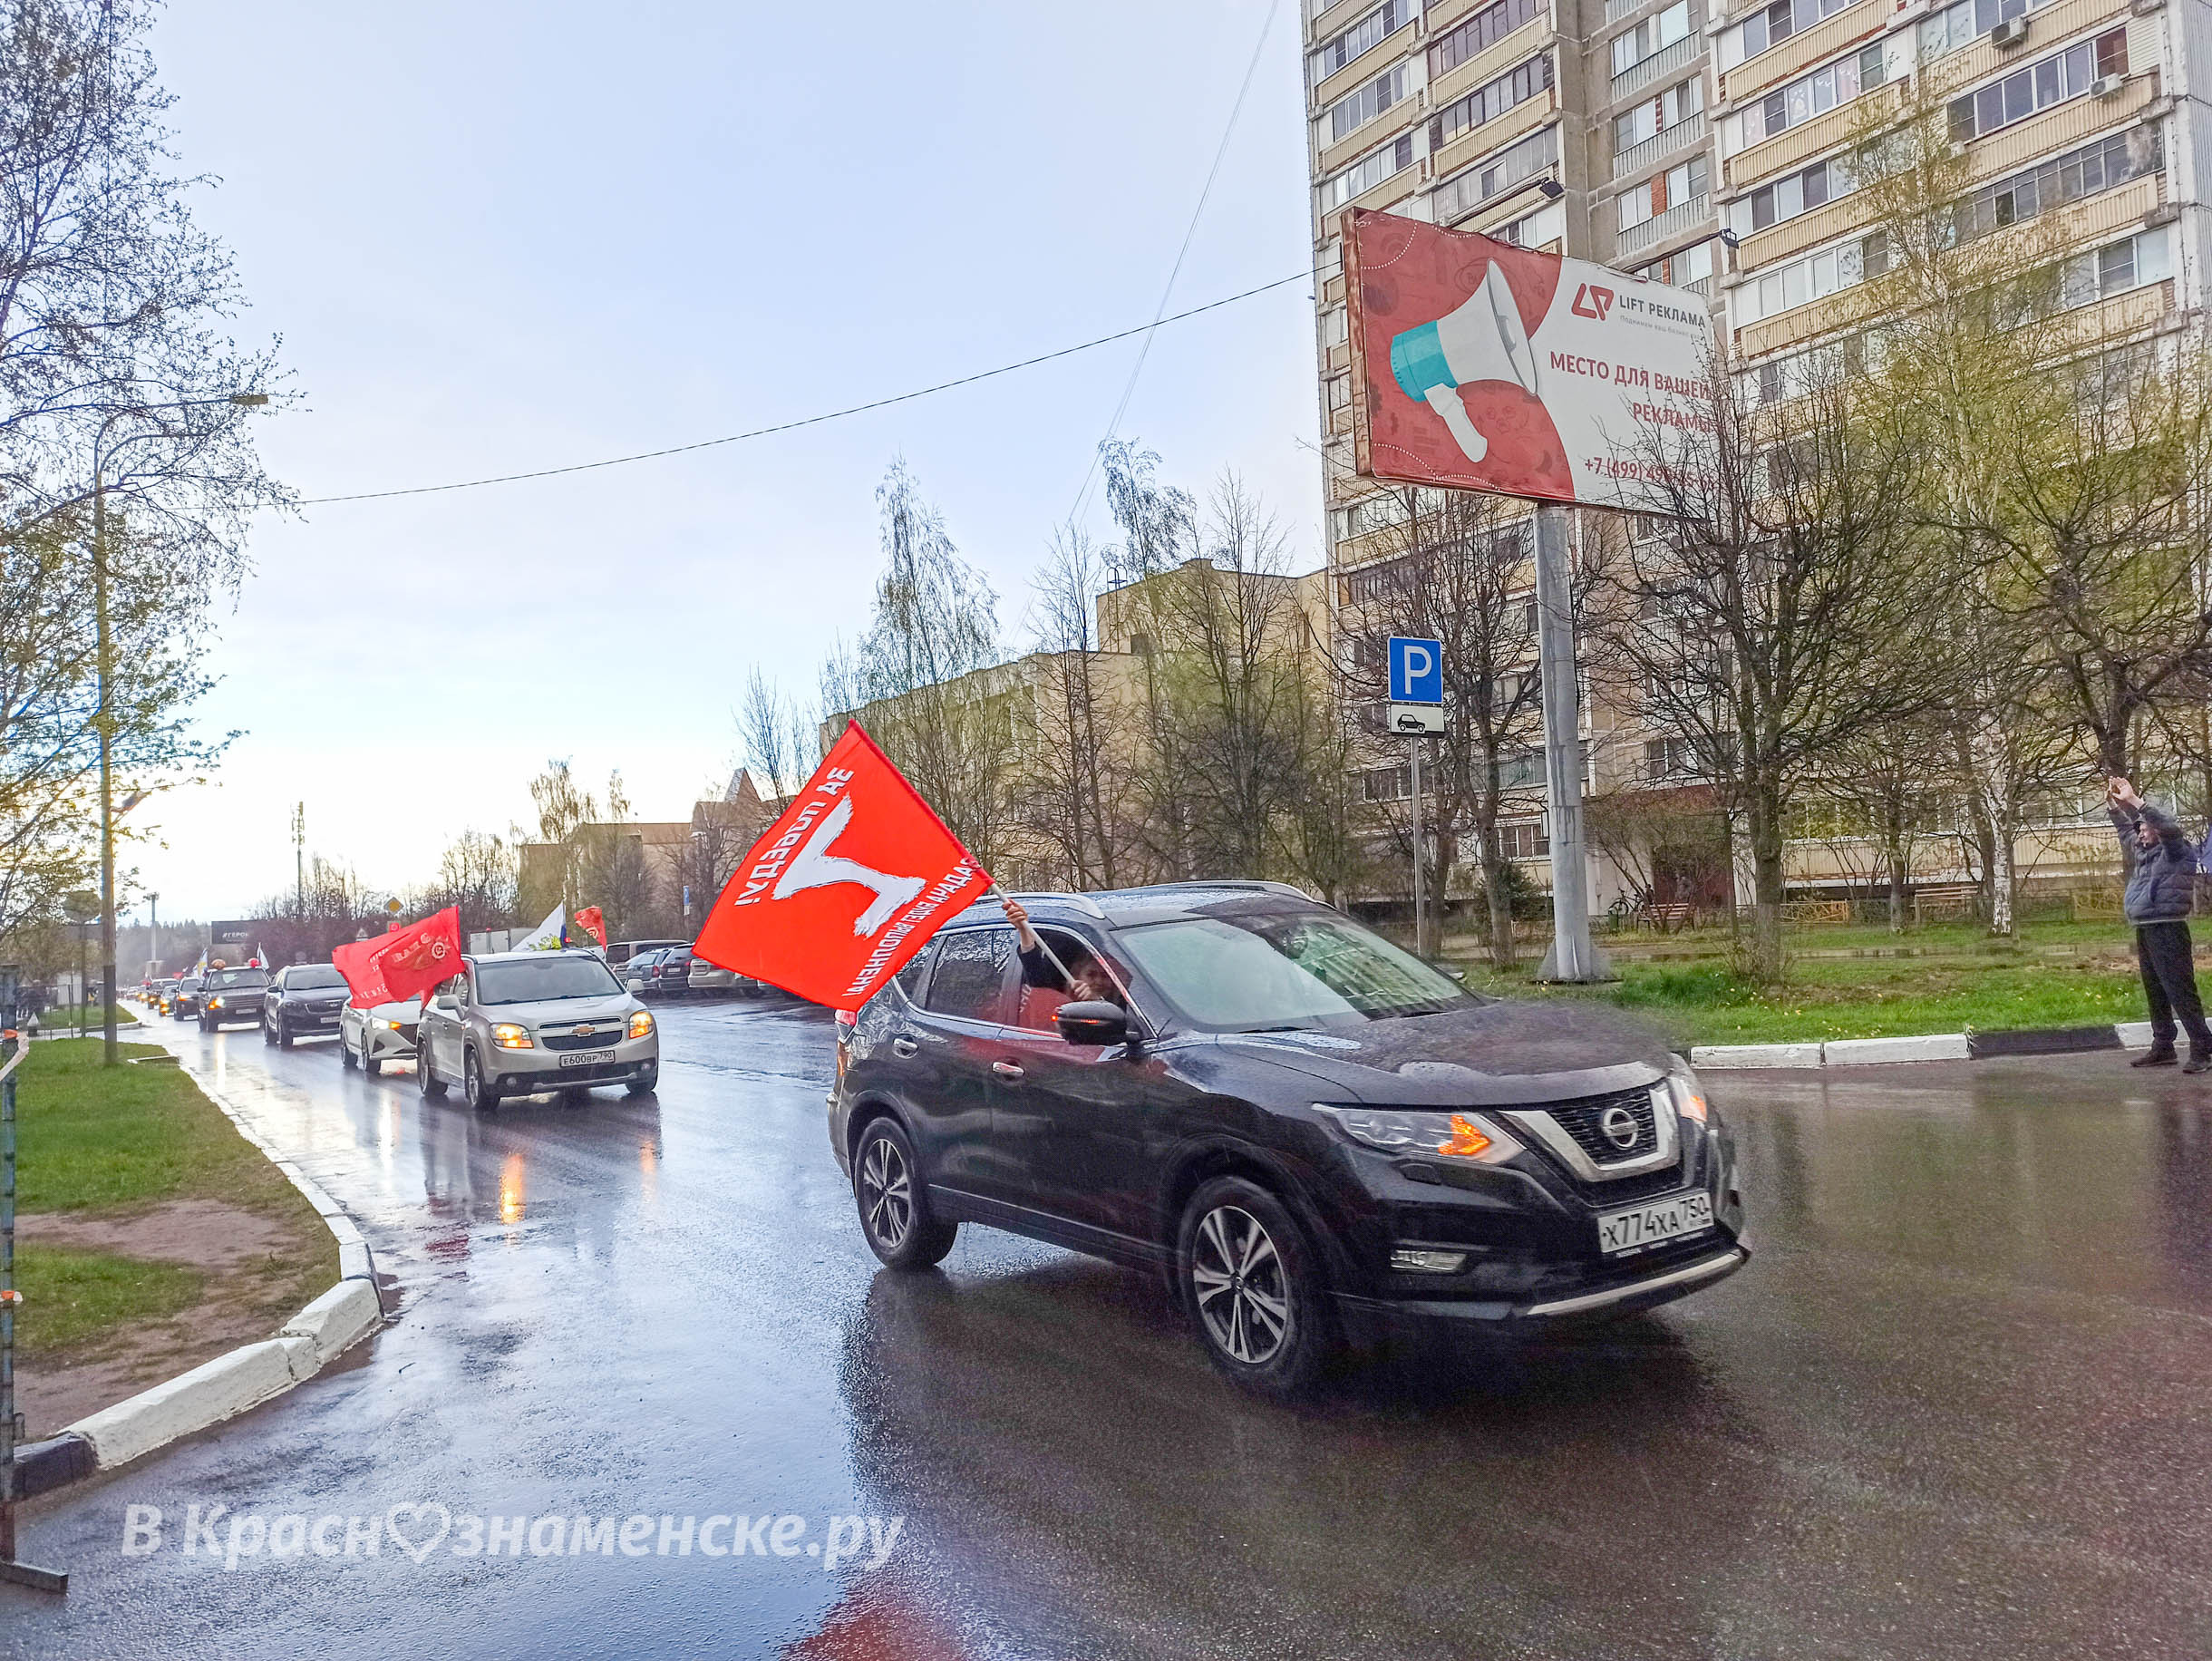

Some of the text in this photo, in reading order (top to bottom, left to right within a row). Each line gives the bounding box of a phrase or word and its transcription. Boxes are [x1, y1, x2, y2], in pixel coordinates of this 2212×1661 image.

[1619, 296, 1706, 327] LIFT РЕКЛАМА
[1550, 351, 1609, 380] МЕСТО
[1614, 365, 1650, 387] ДЛЯ
[1585, 457, 1603, 474] +7
[1606, 457, 1643, 482] (499)
[1403, 645, 1431, 695] P
[563, 1054, 597, 1065] Е600ВР
[1605, 1209, 1680, 1248] Х774ХА
